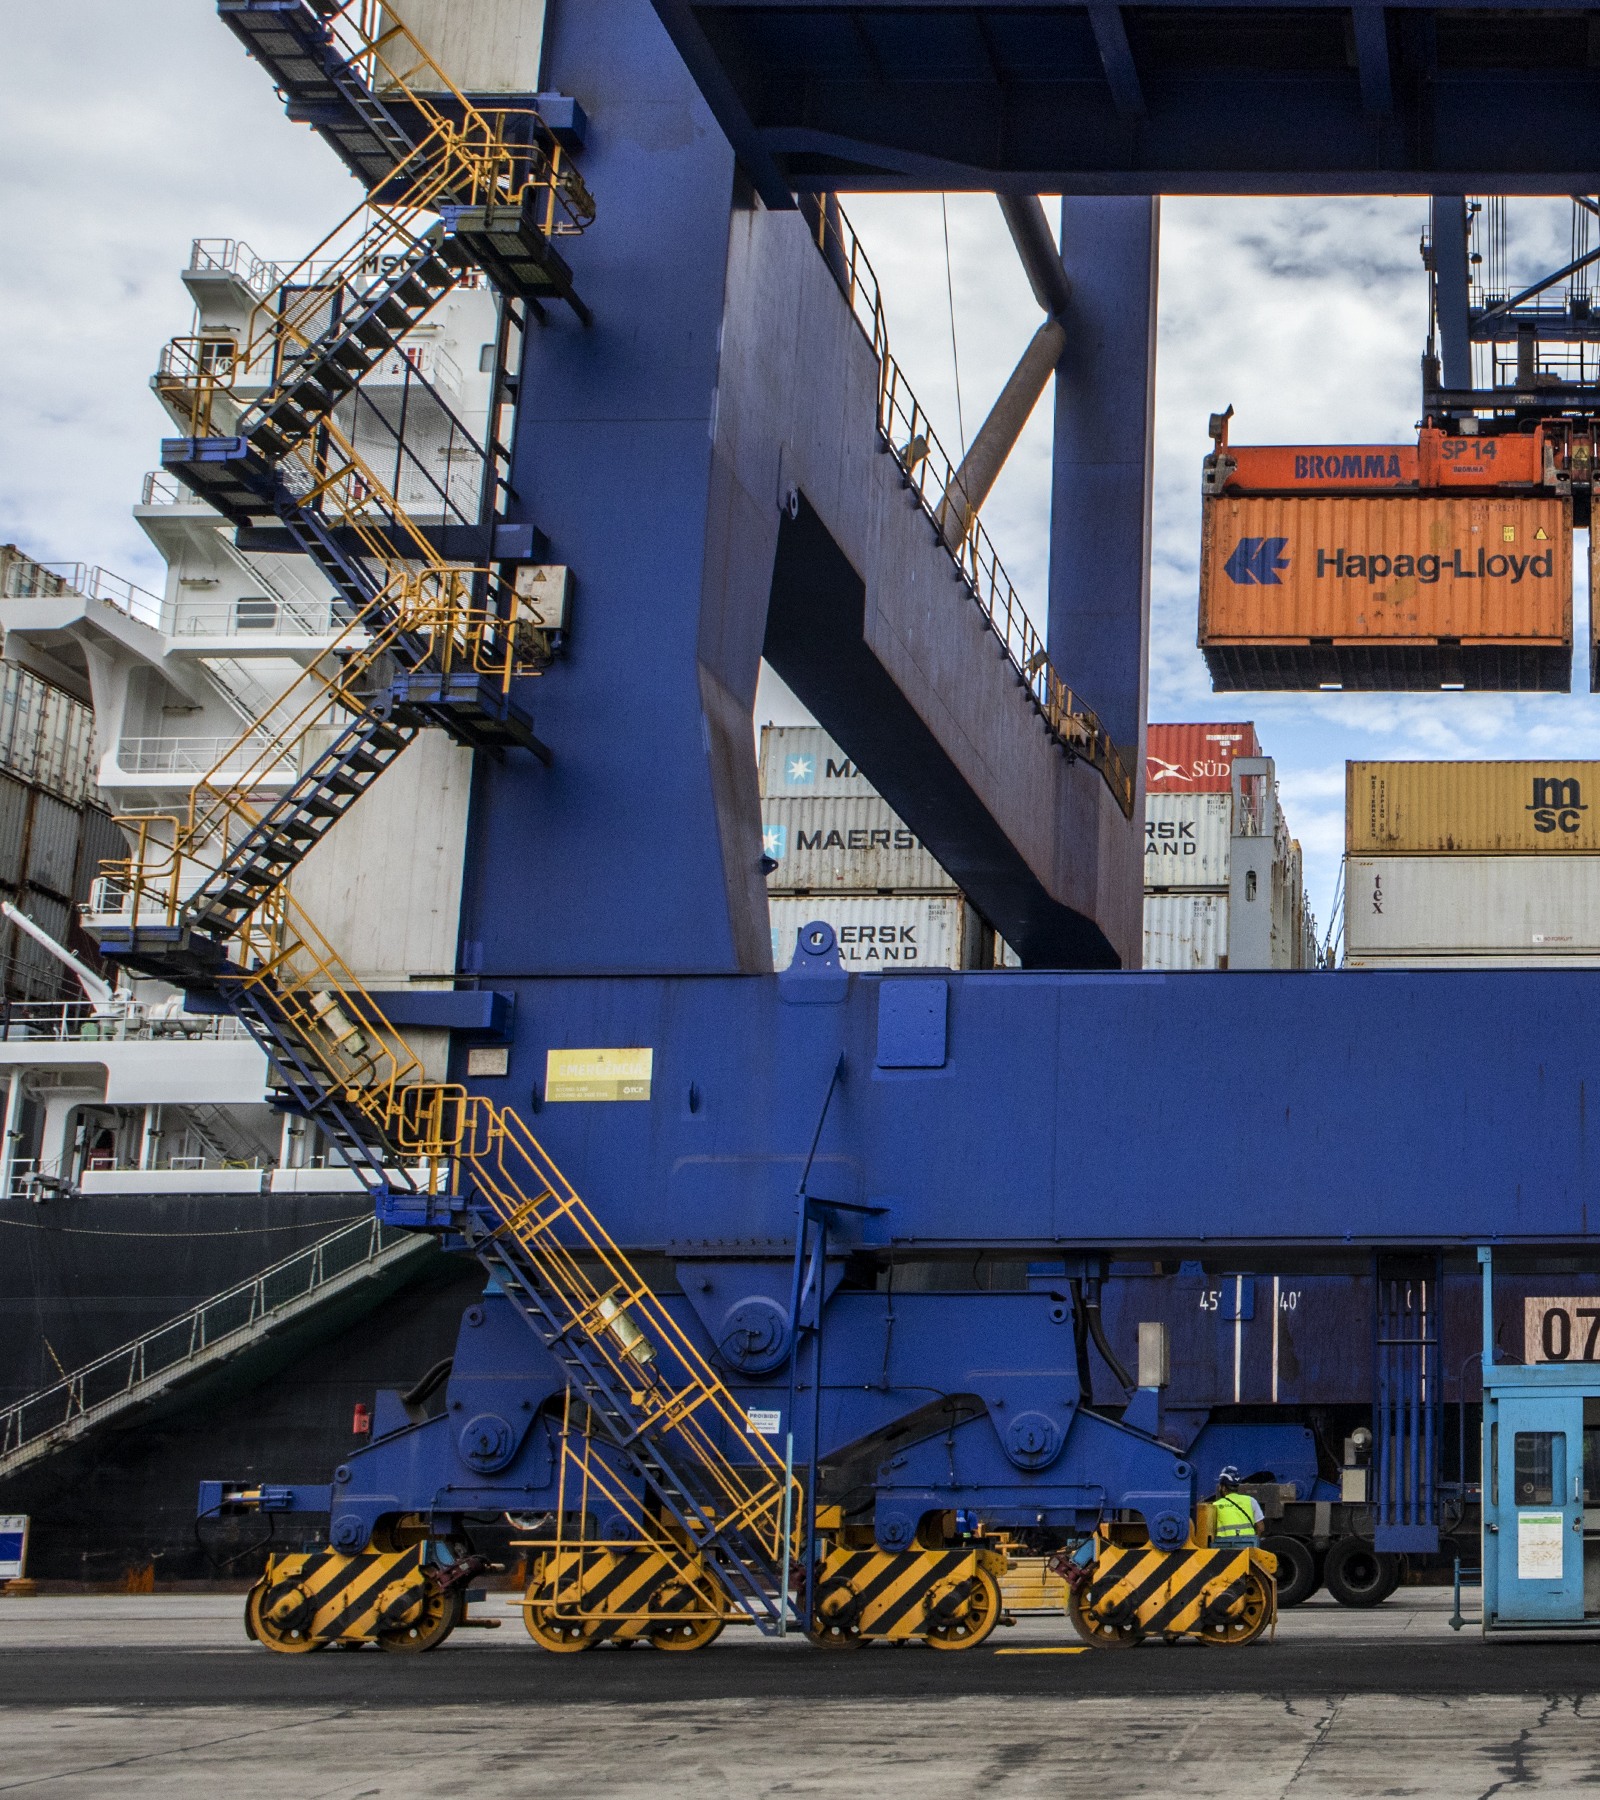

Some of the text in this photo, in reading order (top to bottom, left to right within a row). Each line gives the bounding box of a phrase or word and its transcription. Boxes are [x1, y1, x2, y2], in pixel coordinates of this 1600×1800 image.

[1441, 440, 1497, 461] SP 14
[1295, 455, 1401, 479] BROMMA
[1317, 548, 1554, 584] Hapag-Lloyd
[1192, 760, 1230, 777] SÜD
[1380, 823, 1385, 832] CO
[797, 829, 930, 850] MAERS
[1373, 874, 1383, 914] tex
[559, 1060, 643, 1077] EMERGÊNCIA
